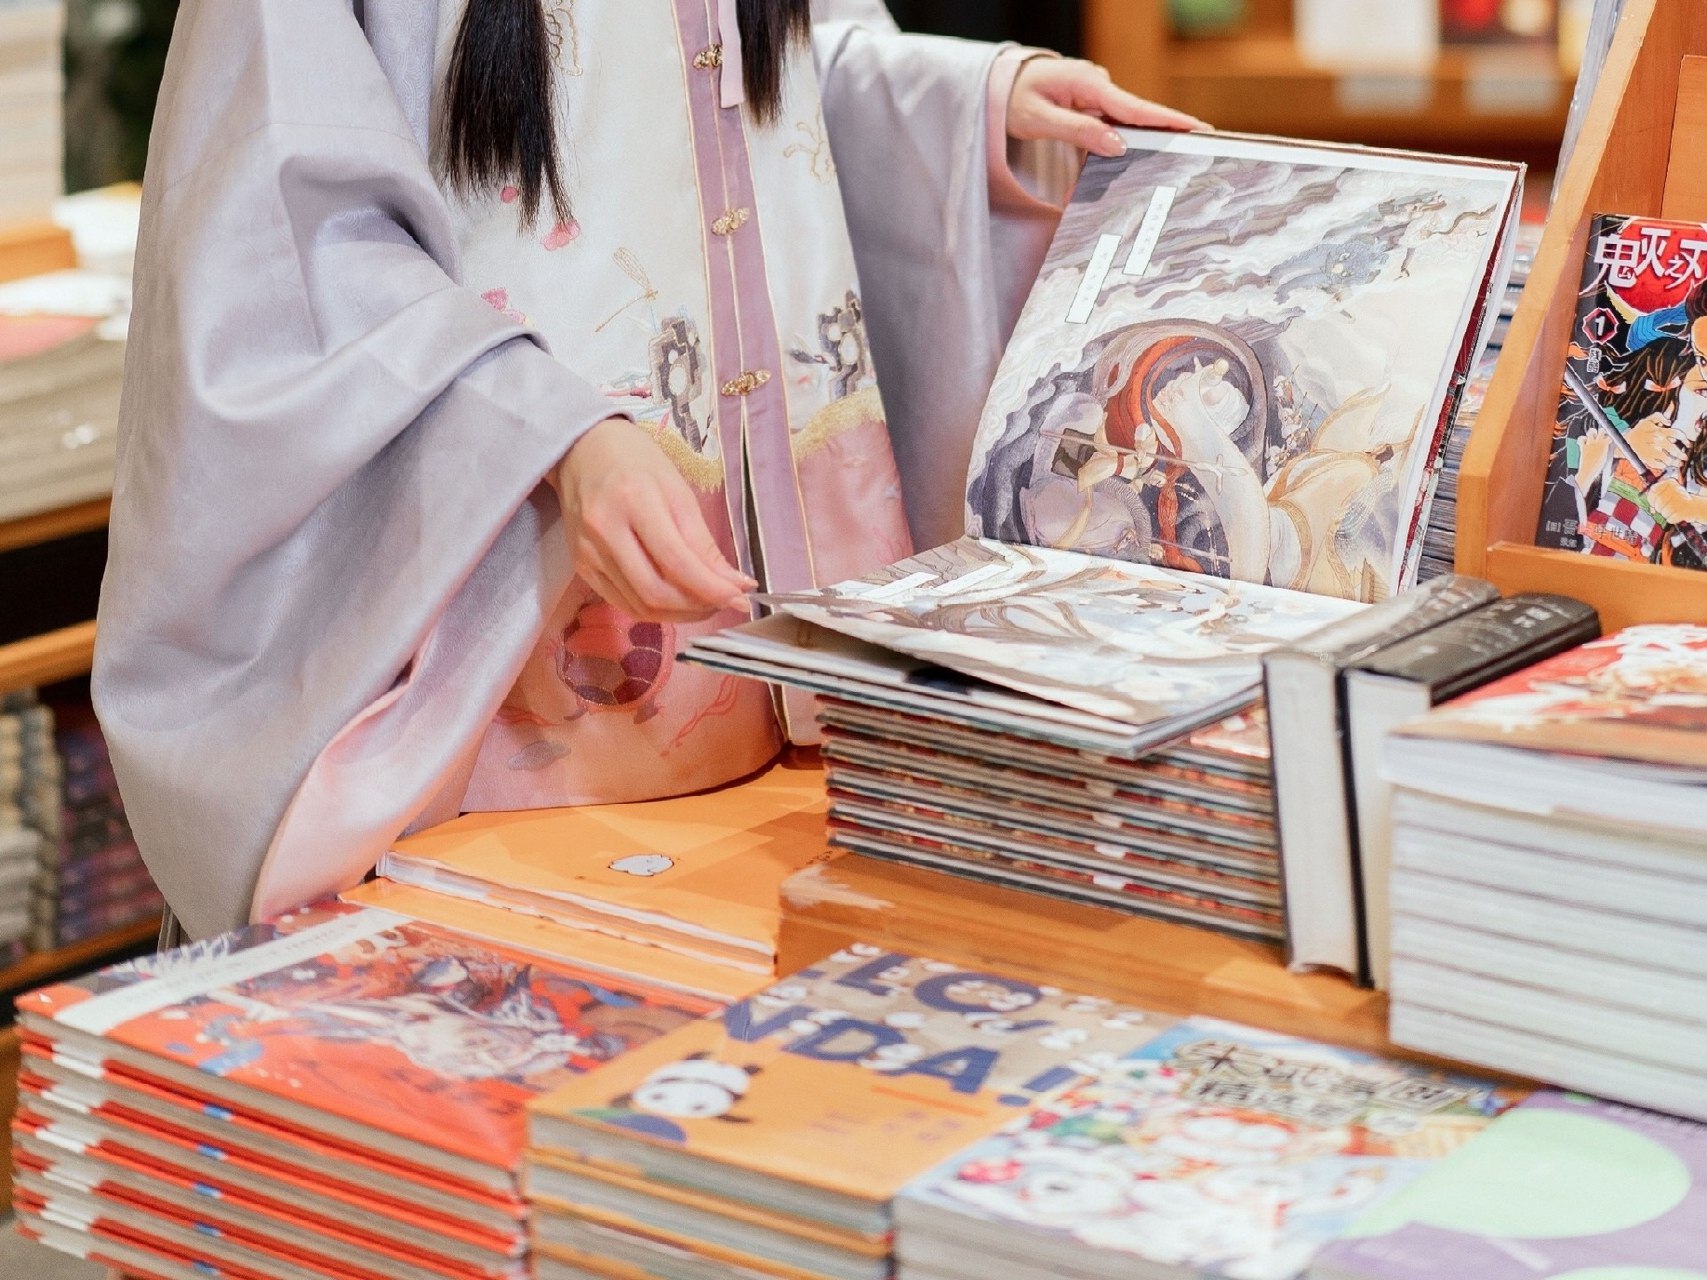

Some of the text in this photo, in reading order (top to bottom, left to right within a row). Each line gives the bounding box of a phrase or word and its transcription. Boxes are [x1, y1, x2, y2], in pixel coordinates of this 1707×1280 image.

[1579, 227, 1707, 294] 鬼灭之刃
[1594, 316, 1606, 336] 1
